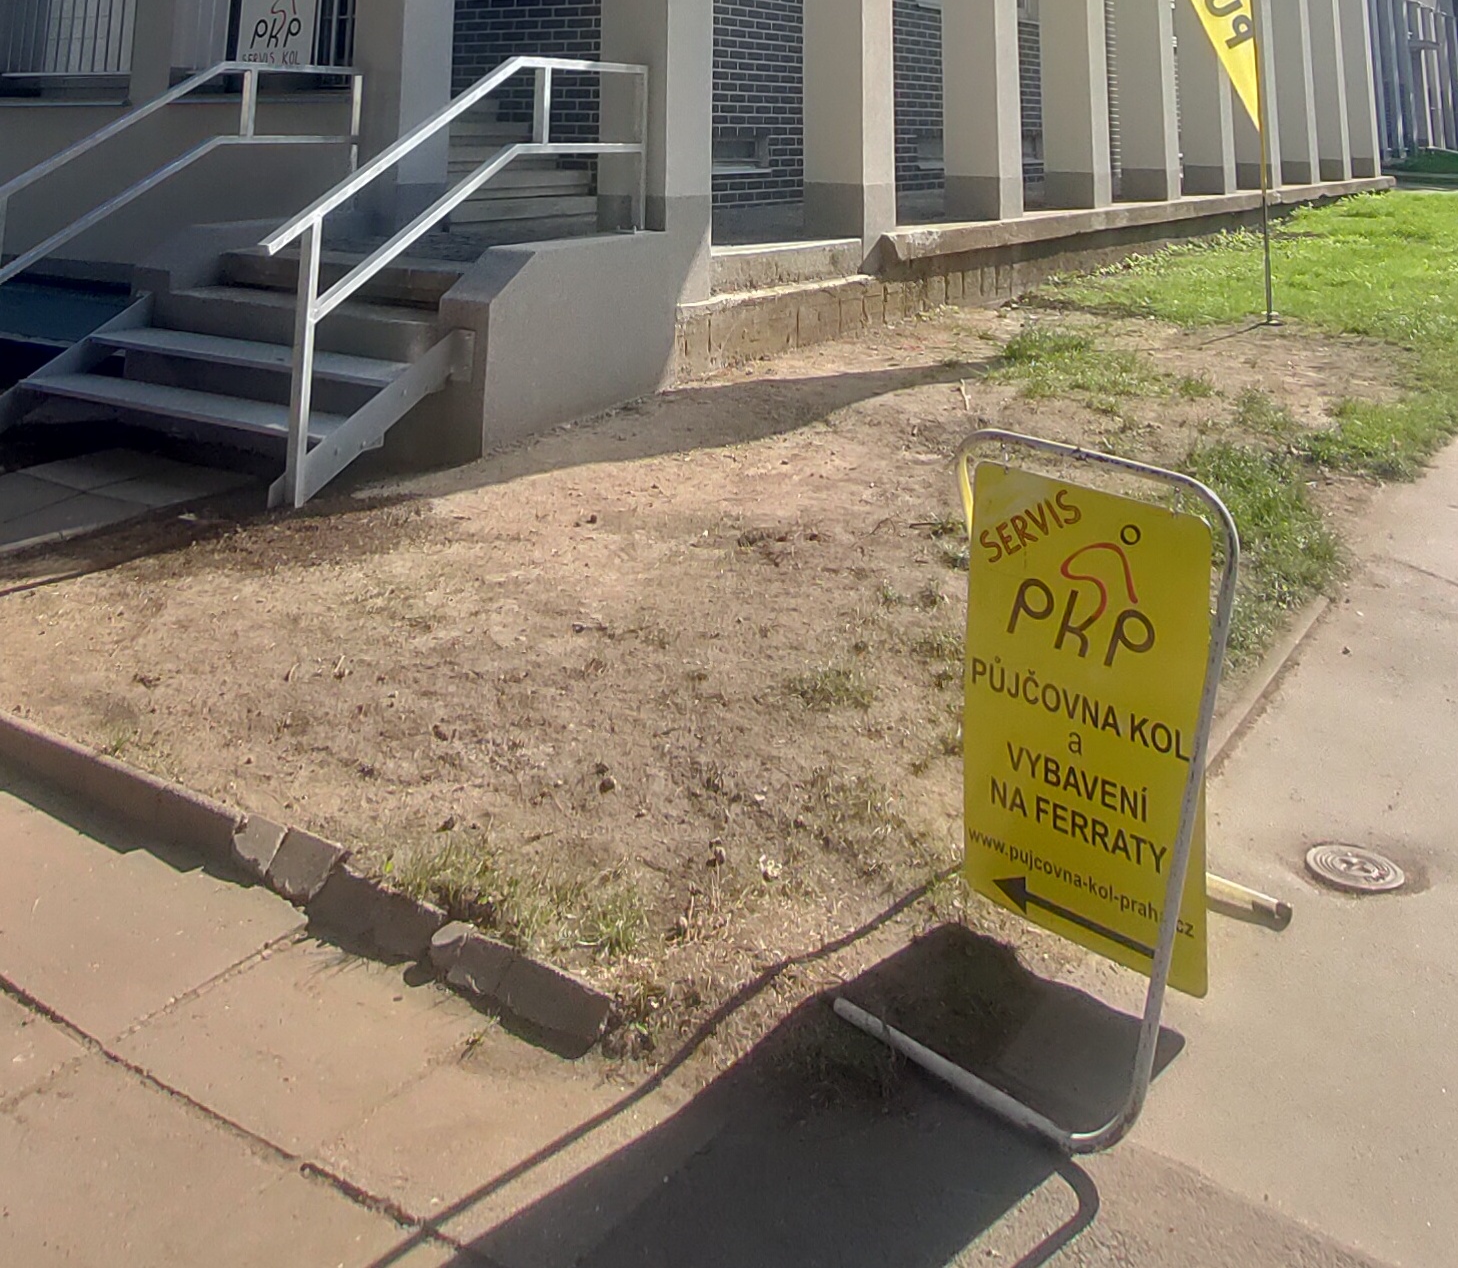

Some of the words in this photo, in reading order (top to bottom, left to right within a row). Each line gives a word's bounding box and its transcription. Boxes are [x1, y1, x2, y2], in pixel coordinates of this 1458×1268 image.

[281, 50, 301, 65] KOL
[979, 489, 1082, 563] SERVIS
[971, 655, 1121, 738] PŮJČOVNA
[1130, 713, 1191, 762] KOL
[1067, 732, 1083, 756] a
[1007, 741, 1148, 823] VYBAVENÍ
[990, 776, 1028, 818] NA
[1035, 795, 1168, 875] FERRATY
[968, 828, 1195, 938] www.pujcovna-kol-prahcz
